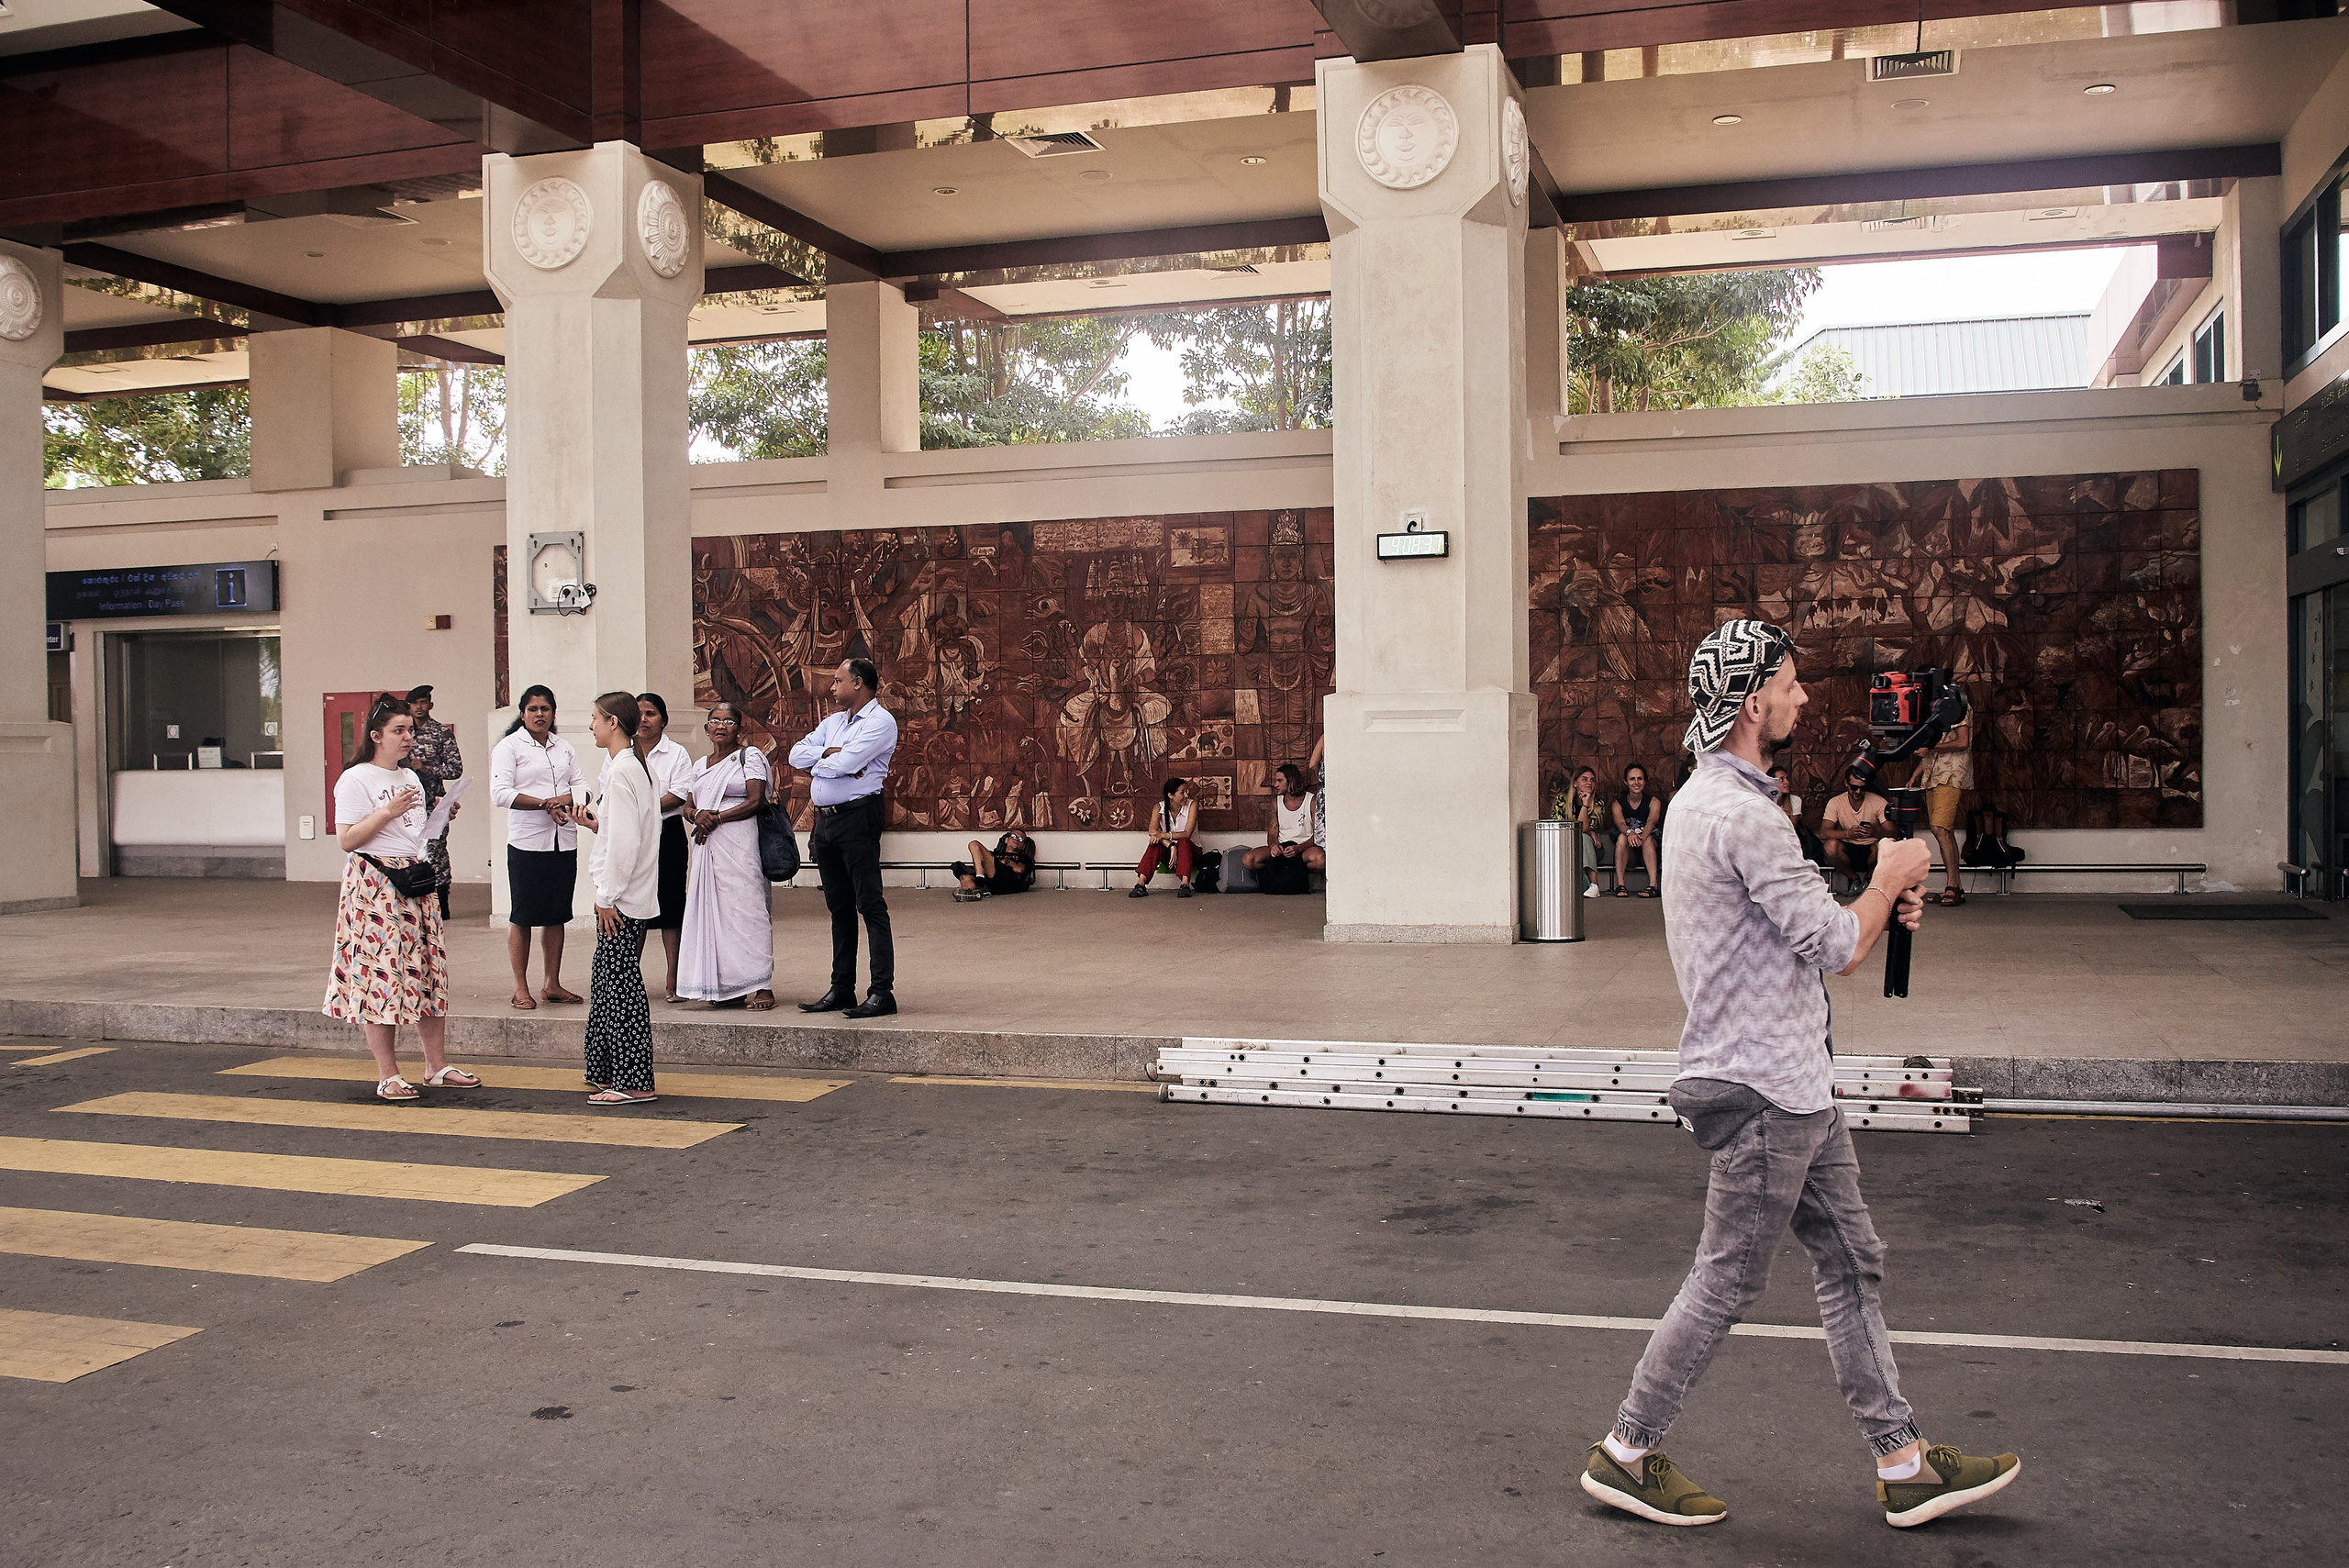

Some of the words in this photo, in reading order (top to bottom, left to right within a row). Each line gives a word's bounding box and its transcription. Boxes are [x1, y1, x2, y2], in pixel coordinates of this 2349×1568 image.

[99, 601, 142, 611] Information
[148, 599, 163, 610] Day
[164, 598, 184, 608] Pass
